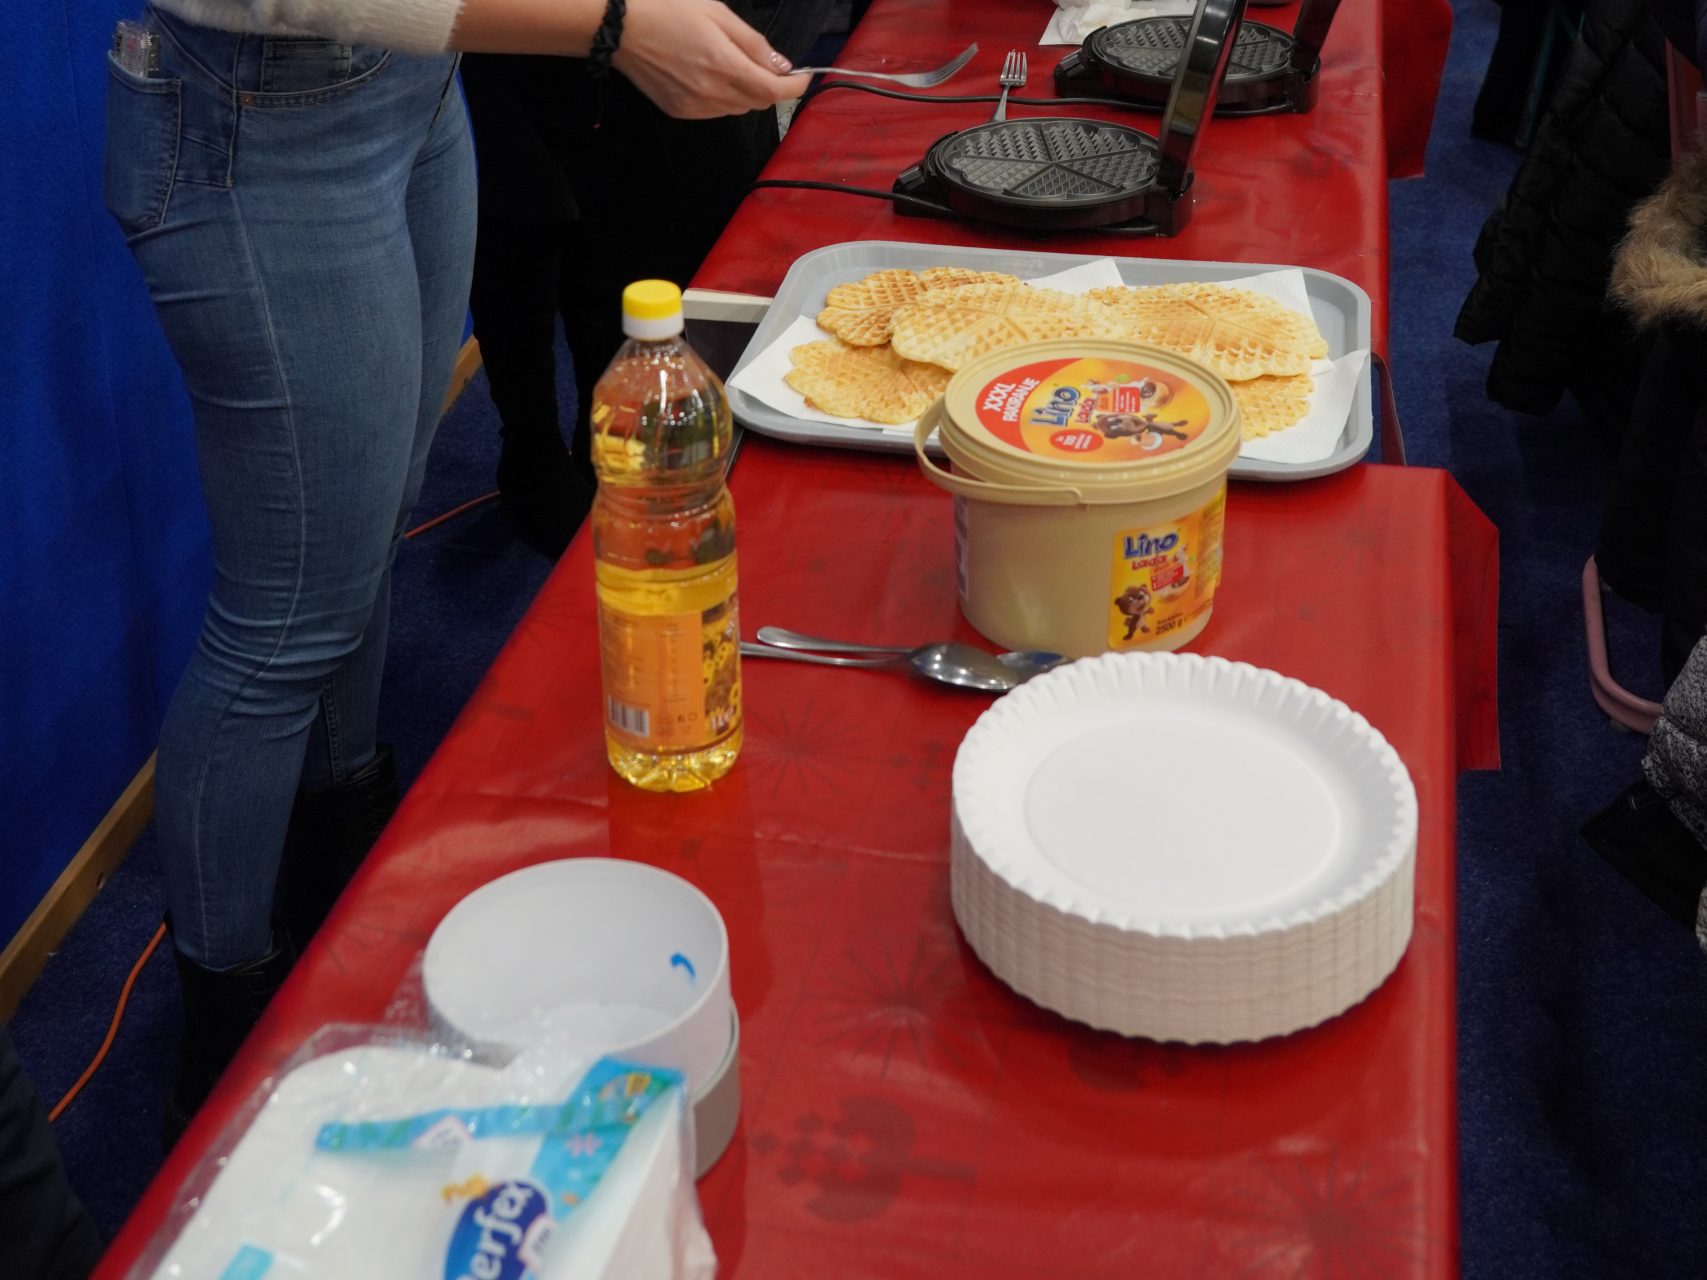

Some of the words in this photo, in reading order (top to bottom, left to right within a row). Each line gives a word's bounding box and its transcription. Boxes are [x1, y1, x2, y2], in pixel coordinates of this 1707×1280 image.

[983, 383, 1016, 412] XXXL
[1003, 378, 1040, 421] PAKIRANJE
[1030, 386, 1081, 426] Lino
[1124, 533, 1178, 559] Lino
[456, 1181, 535, 1280] erfex
